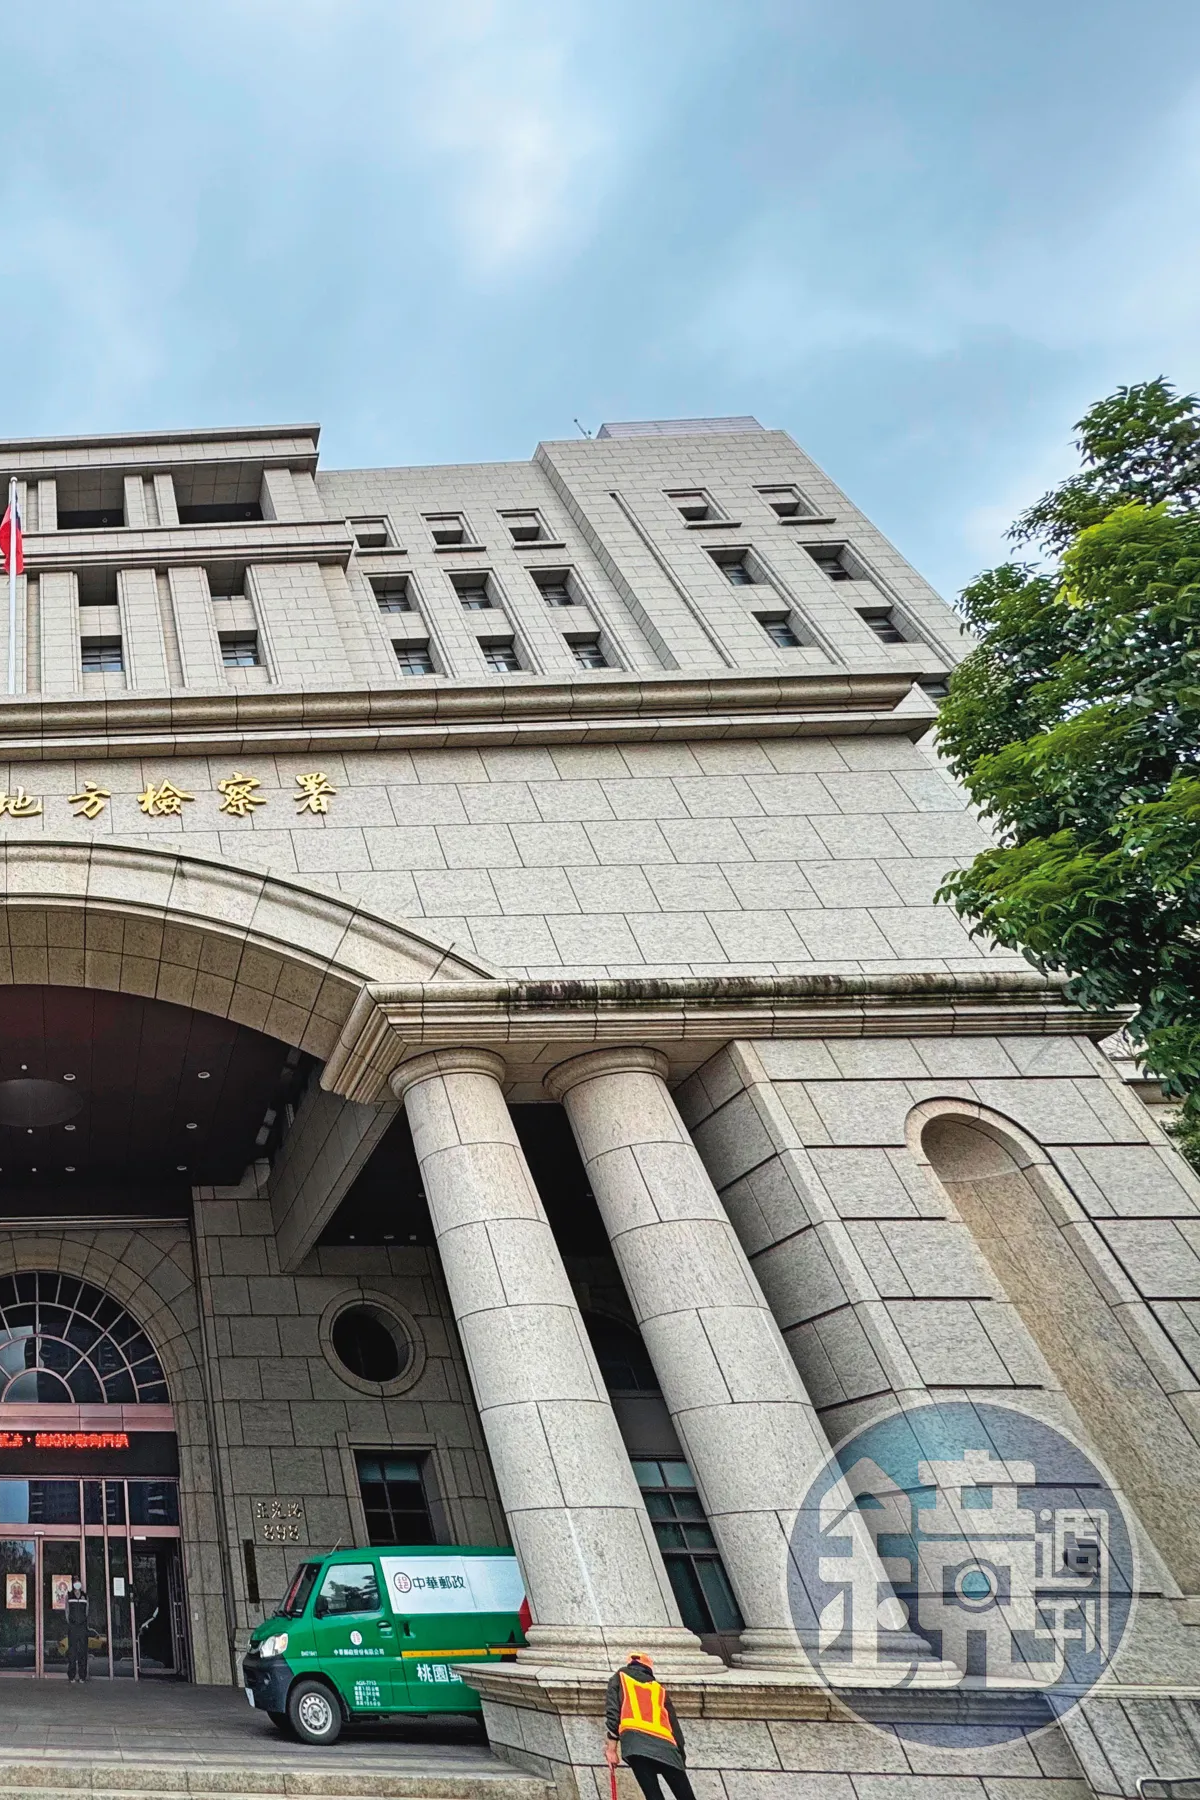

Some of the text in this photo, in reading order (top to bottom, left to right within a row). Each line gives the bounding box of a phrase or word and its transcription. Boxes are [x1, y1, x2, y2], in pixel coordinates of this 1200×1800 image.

[256, 1501, 303, 1519] 正光路
[263, 1524, 300, 1541] 898
[412, 1575, 467, 1590] 中華郵政
